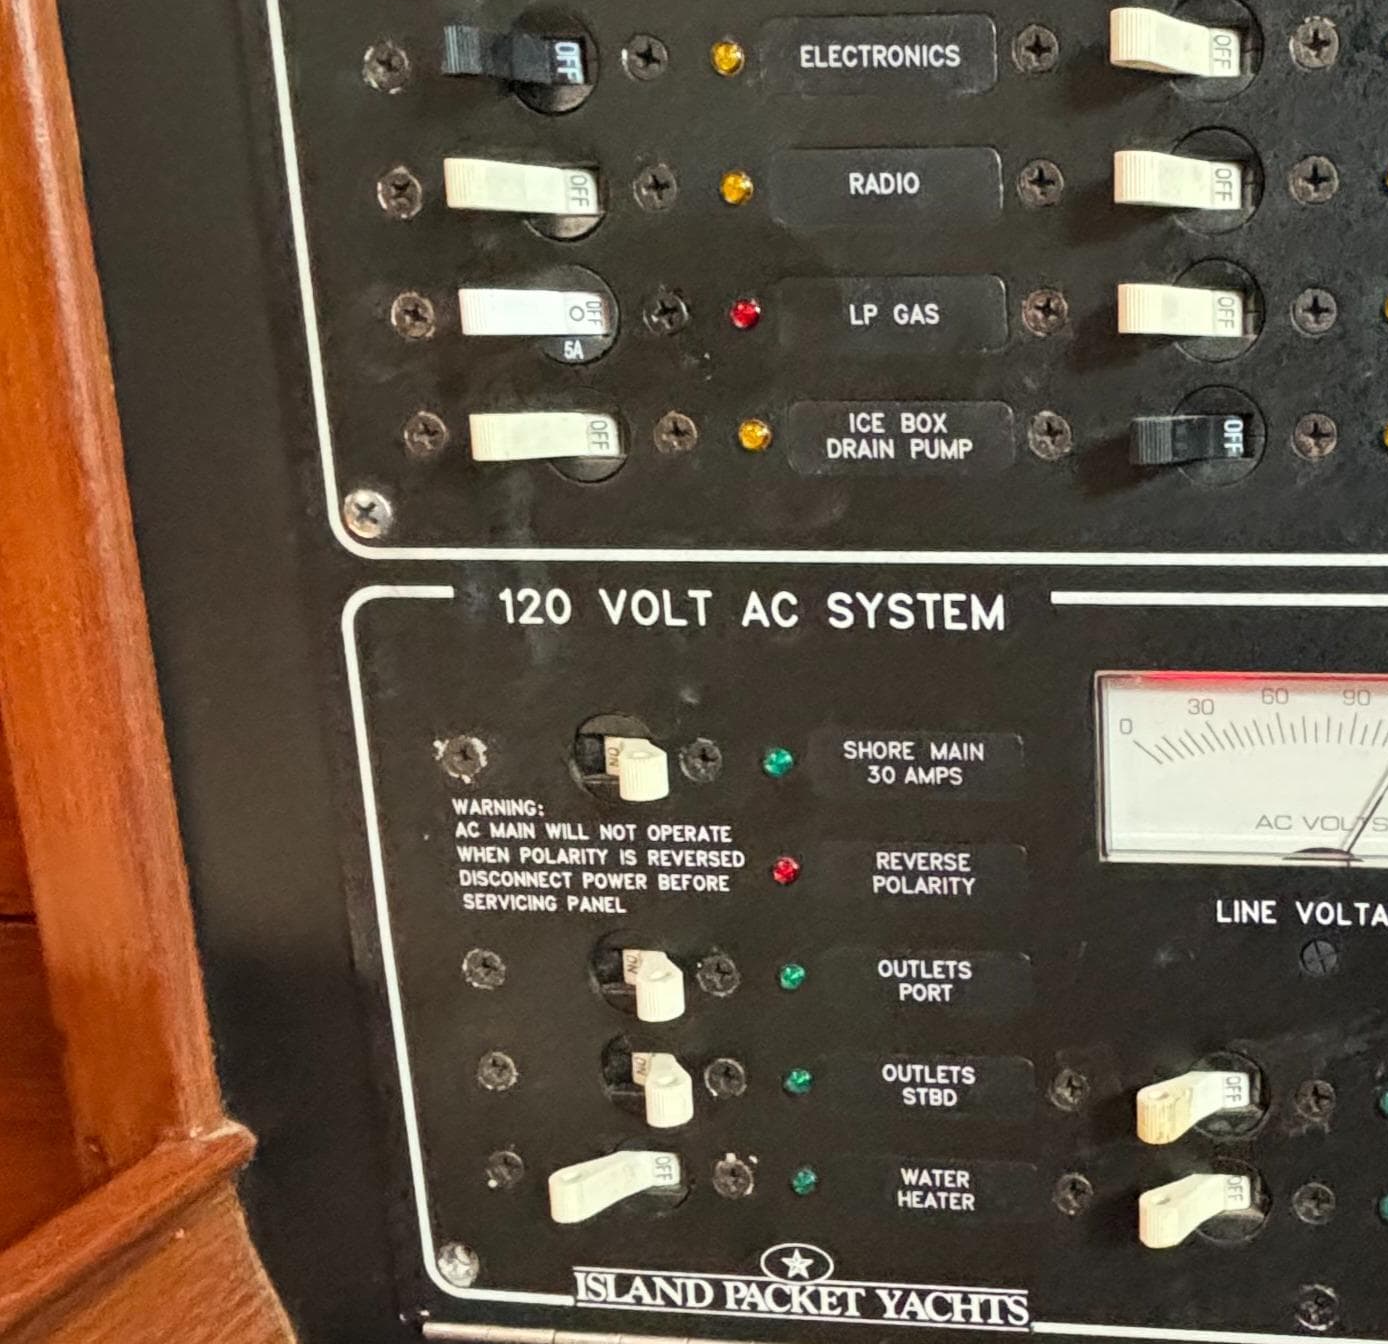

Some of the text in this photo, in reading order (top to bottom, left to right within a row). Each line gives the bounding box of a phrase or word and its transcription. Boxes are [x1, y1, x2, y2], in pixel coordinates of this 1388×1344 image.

[554, 42, 583, 83] OFF
[800, 44, 961, 68] ELECTRONICS
[849, 171, 920, 195] RADIO
[1214, 167, 1233, 203] OFF
[849, 303, 940, 325] LP GAS
[564, 340, 584, 360] 5A
[849, 412, 948, 434] ICE BOX
[586, 418, 609, 451] OFF
[1223, 418, 1243, 457] OFF
[826, 437, 973, 460] DRAIN PUMP
[498, 587, 1005, 631] 120 VOLT AC SYSTEM
[1188, 698, 1214, 716] 30
[1262, 689, 1288, 705] 60
[1343, 689, 1370, 707] 90
[1120, 719, 1133, 735] 0
[843, 740, 984, 761] SHORE MAIN
[867, 765, 963, 786] 30 AMPS
[451, 798, 545, 817] WARNING:
[455, 820, 732, 843] AC MAIN WILL NOT OPERATE
[1255, 814, 1292, 831] AC
[456, 845, 746, 868] WHEN POLARITY IS REVERSED
[876, 851, 971, 872] REVERSE
[459, 869, 730, 892] DISCONNECT POWER BEFORE
[872, 875, 976, 896] POLARITY
[462, 892, 627, 914] SERVICING PANEL
[1216, 899, 1277, 924] LINE
[877, 959, 972, 980] OUTLETS
[899, 982, 953, 1002] PORT
[881, 1063, 976, 1085] OUTLETS
[902, 1086, 958, 1107] STBD
[1226, 1076, 1241, 1103] OFF
[900, 1167, 970, 1189] WATER
[897, 1190, 975, 1211] HEATER
[575, 1271, 1030, 1325] ISLAND PACKET YACHTS
